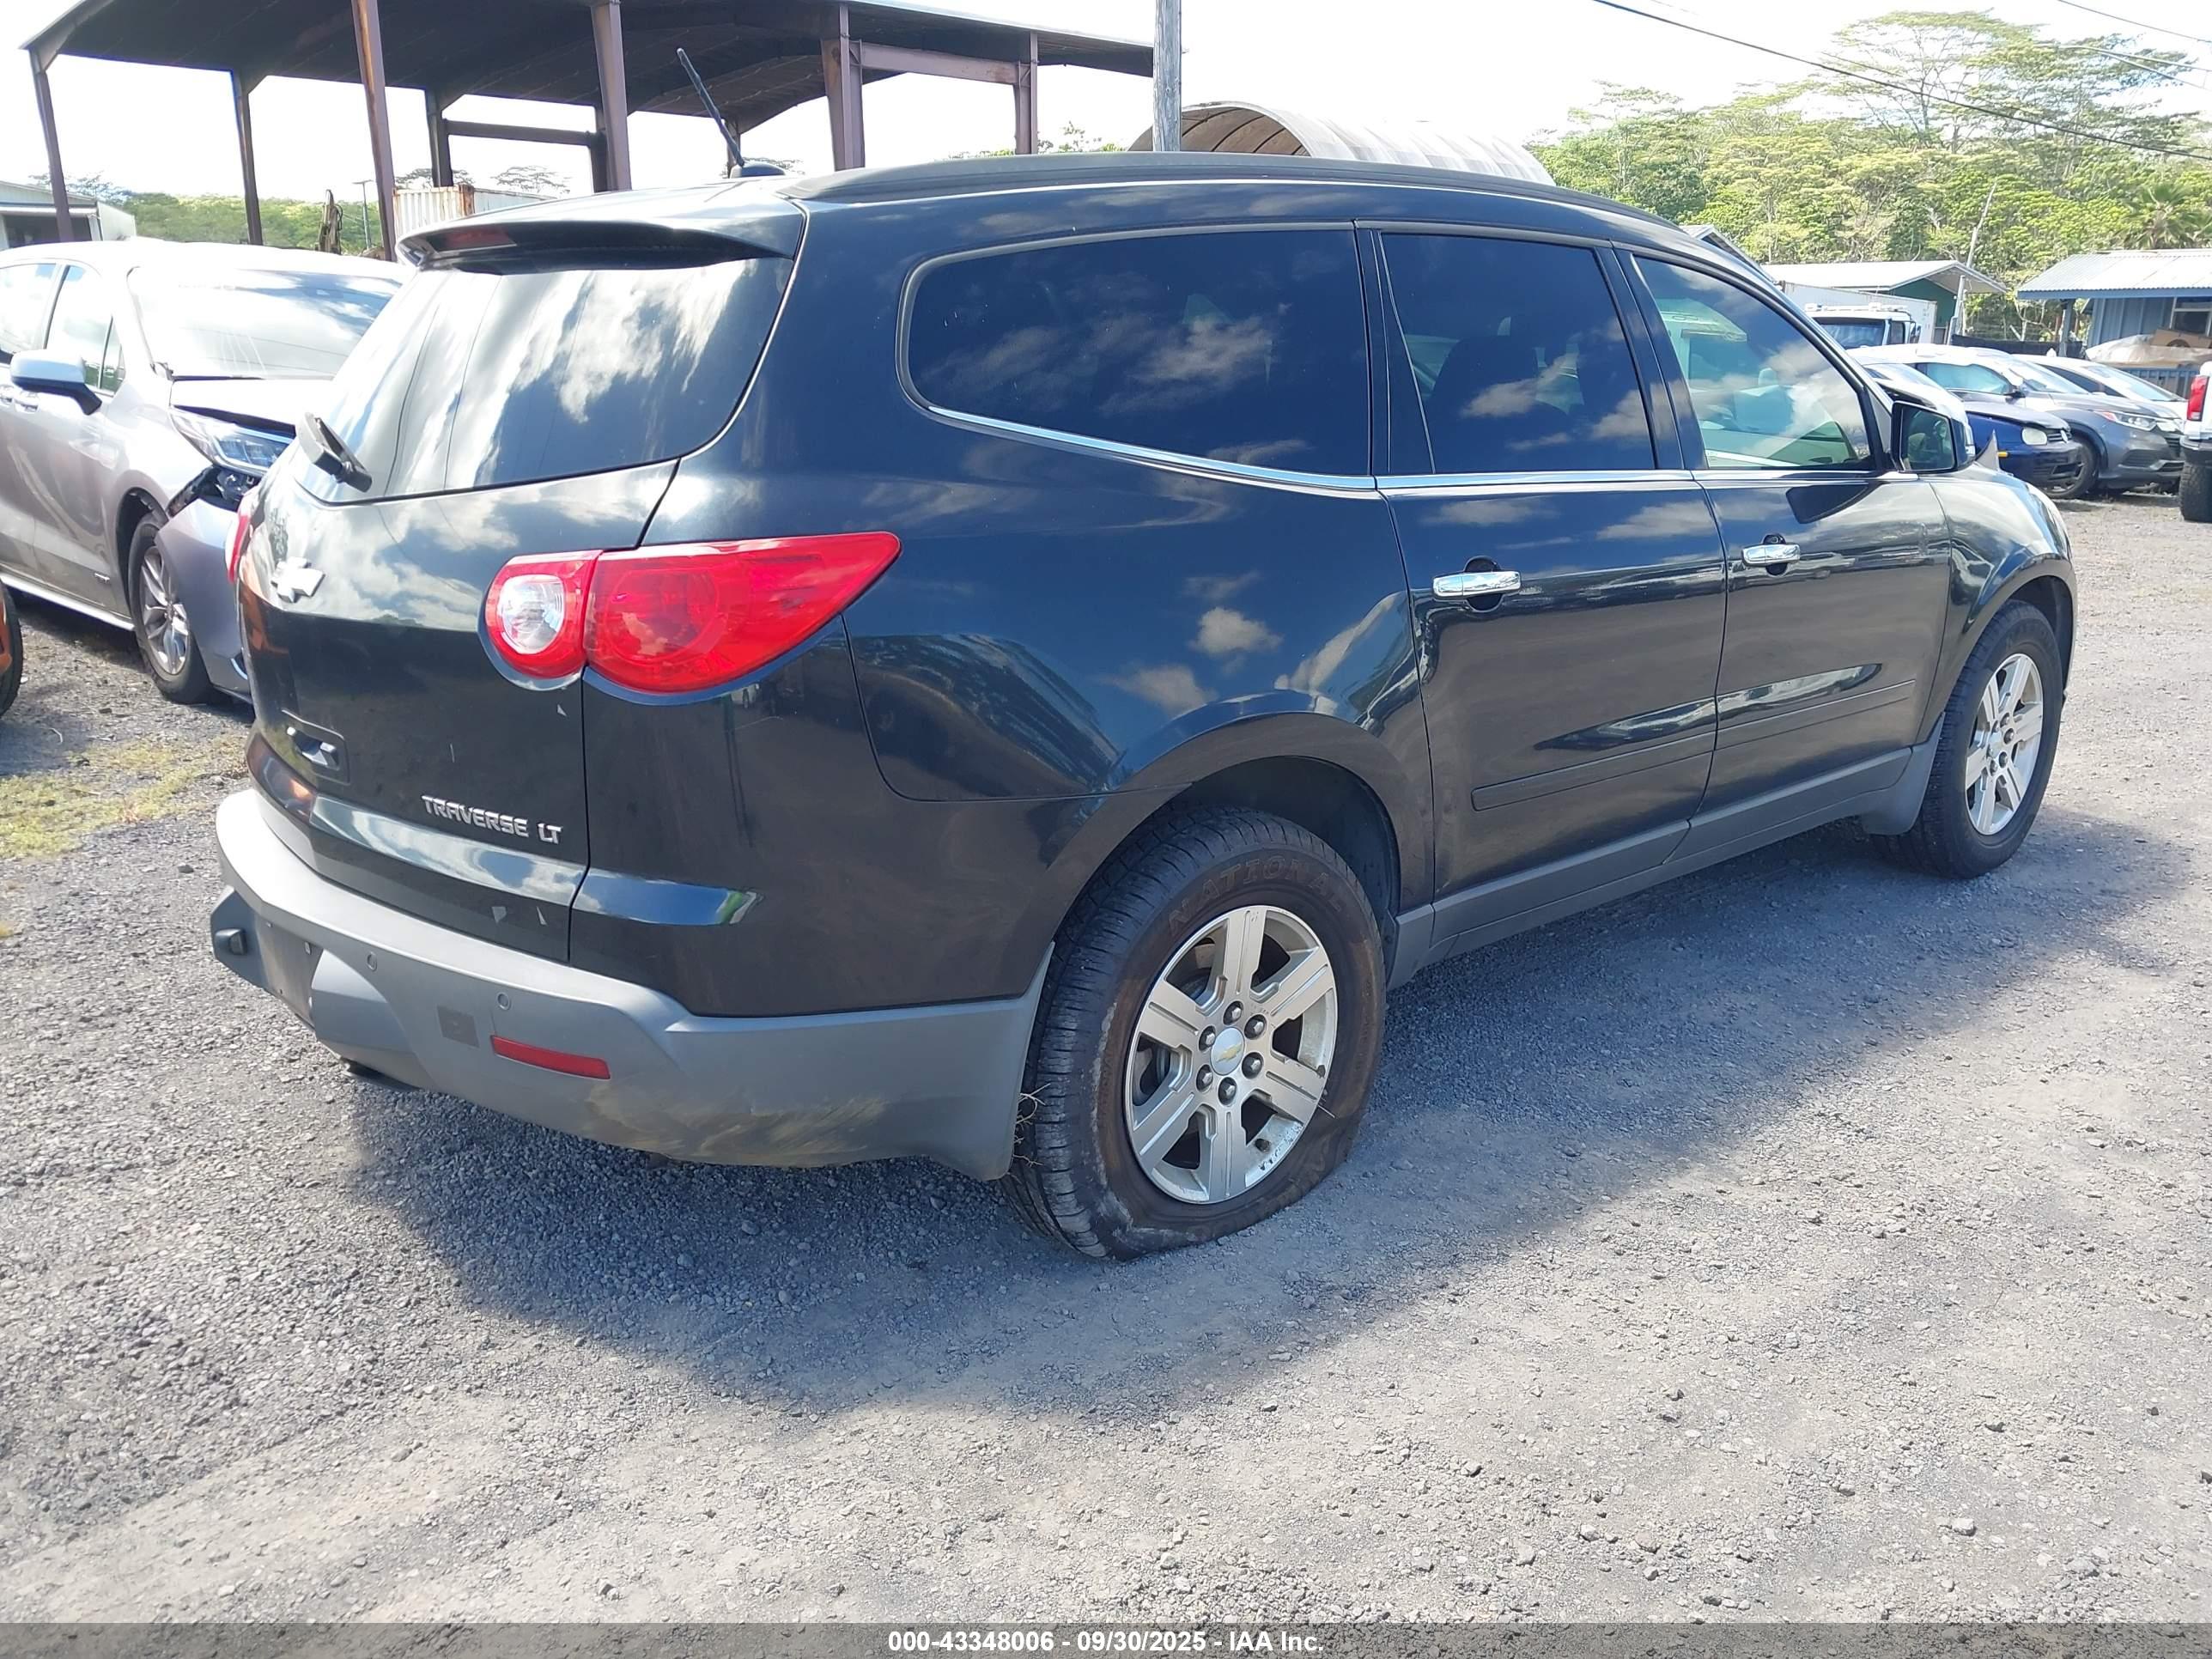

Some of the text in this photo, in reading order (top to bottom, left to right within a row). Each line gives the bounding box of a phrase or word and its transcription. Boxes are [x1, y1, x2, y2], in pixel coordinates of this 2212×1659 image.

[422, 794, 563, 844] TRAVERSE LT
[1168, 854, 1344, 936] NATIONAL
